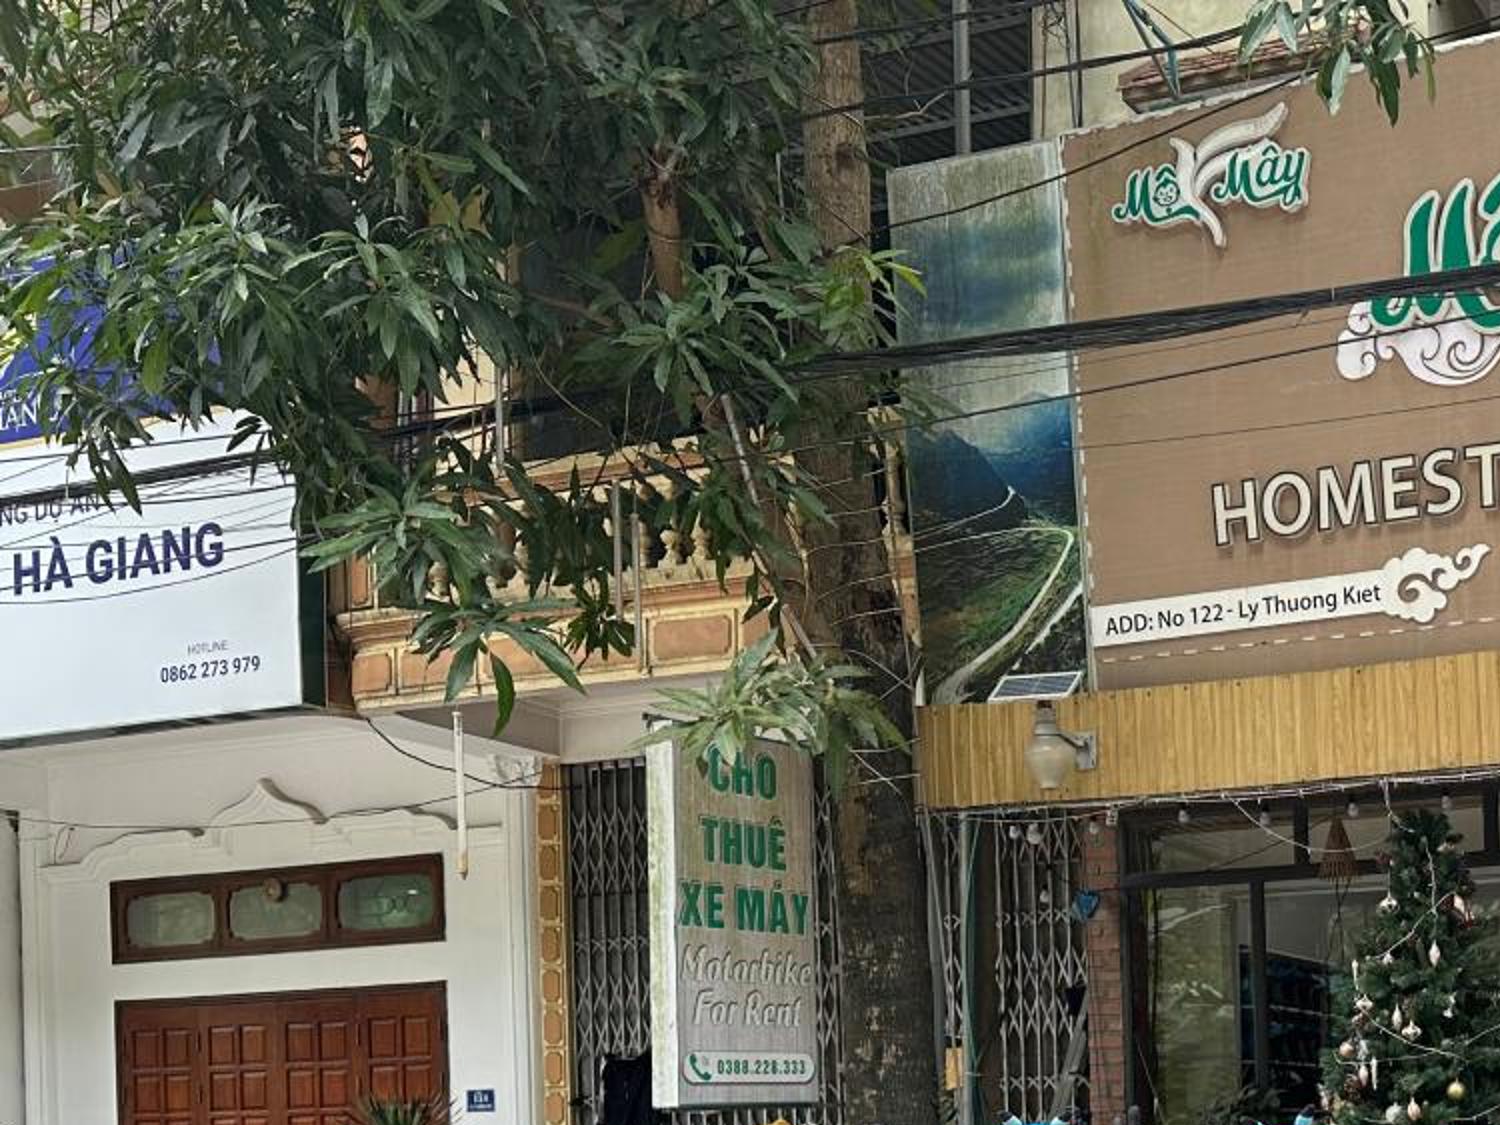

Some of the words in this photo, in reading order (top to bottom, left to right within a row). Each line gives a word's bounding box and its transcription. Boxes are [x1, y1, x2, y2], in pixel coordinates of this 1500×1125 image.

[1213, 144, 1307, 208] Mây
[14, 535, 73, 596] HÀ
[86, 522, 224, 584] GIANG
[1105, 613, 1153, 637] ADD:
[1158, 610, 1185, 629] No
[1239, 600, 1258, 621] Ly
[1262, 591, 1337, 615] Thuong
[160, 663, 197, 682] 0862
[201, 659, 228, 678] 273
[233, 655, 260, 674] 979
[707, 742, 776, 800] CHO
[700, 816, 786, 870] THUÊ
[680, 880, 725, 929] XE
[736, 880, 809, 935] MÁY
[681, 944, 812, 986] Motorbike
[693, 988, 737, 1025] For
[744, 989, 802, 1027] Rent
